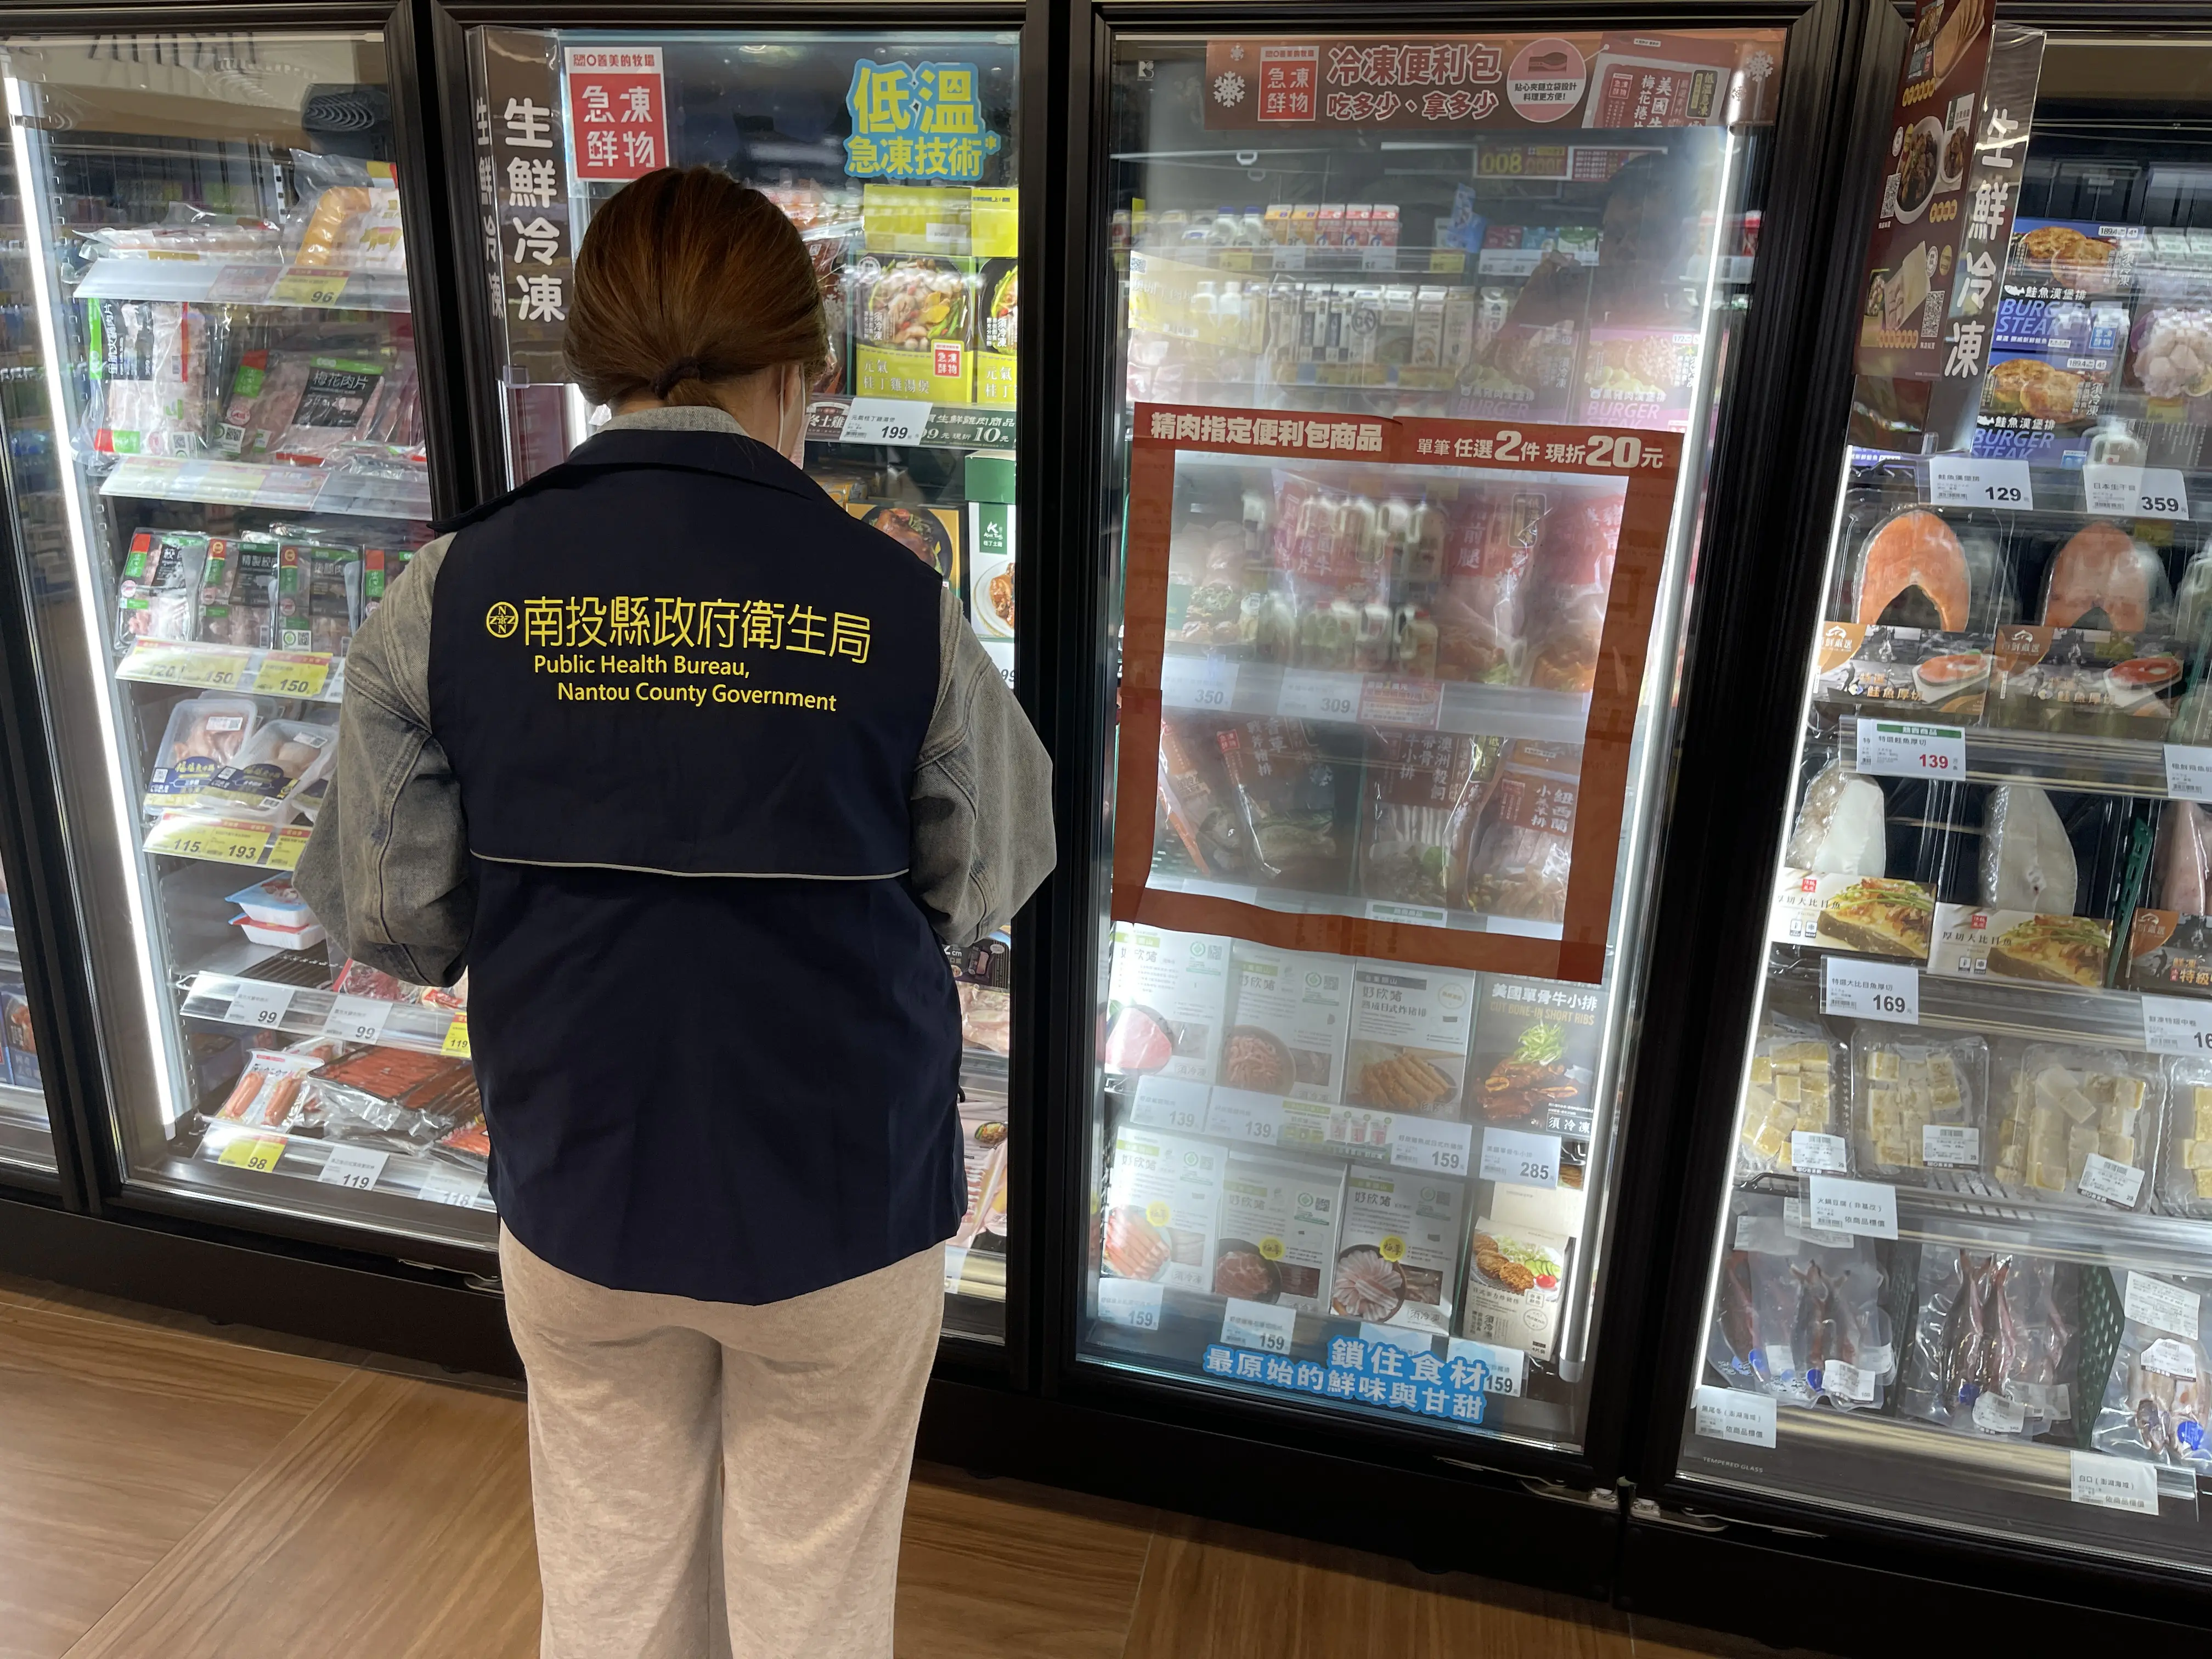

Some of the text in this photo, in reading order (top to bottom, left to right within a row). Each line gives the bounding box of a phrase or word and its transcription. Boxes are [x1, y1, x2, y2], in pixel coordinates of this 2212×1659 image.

[1327, 43, 1502, 86] 冷凍便利包
[1267, 67, 1309, 89] 急凍
[1514, 82, 1577, 92] 貼心夾鏈立袋設計
[582, 85, 653, 123] 急凍
[854, 65, 979, 136] 低溫
[1267, 92, 1308, 114] 鮮物
[1327, 89, 1499, 121] 吃多少、拿多少
[586, 130, 656, 168] 鮮物
[848, 136, 982, 178] 急凍技術
[504, 97, 566, 323] 生鮮冷凍
[1944, 108, 2019, 380] 生鮮冷凍
[311, 290, 334, 303] 96
[2025, 286, 2087, 301] 鮭魚漢堡排
[997, 318, 1007, 348] 須冷凍
[1996, 315, 2060, 336] STEAK
[864, 359, 888, 374] 元氣
[986, 366, 1012, 381] 元氣
[313, 370, 369, 390] 梅花肉片
[864, 376, 930, 394] 桂丁雞湯煲
[985, 383, 1017, 399] 桂丁
[2086, 382, 2104, 417] 須冷凍
[1587, 401, 1660, 419] BURGER
[1150, 411, 1383, 452] 精肉指定便利包商品
[1995, 416, 2056, 431] 鮭魚漢堡排
[882, 426, 909, 439] 199
[1974, 427, 2056, 449] BURGER
[1417, 430, 1664, 470] 單筆 任選2件 現折20元
[1985, 486, 2022, 501] 129
[2141, 496, 2179, 512] 359
[523, 595, 871, 664] 南投縣政府衛生局
[534, 655, 750, 679] Public Health Bureau,
[205, 671, 234, 685] 150
[280, 679, 309, 693] 150
[558, 682, 838, 712] Nantou County Government
[1195, 689, 1224, 706] 350
[1866, 685, 1923, 701] 鮭魚厚切
[1321, 697, 1351, 714] 309
[1878, 736, 1927, 747] 特選鮭魚厚切
[1920, 754, 1949, 769] 139
[174, 838, 202, 853] 115
[229, 845, 256, 859] 193
[1942, 930, 2013, 947] 厚切大比目魚
[1832, 978, 1893, 991] 特選大比目魚厚切
[2179, 969, 2212, 986] 特級
[1873, 994, 1905, 1013] 169
[258, 1011, 277, 1024] 99
[1490, 1001, 1595, 1025] CUT BONE-IN SHORT RIBS
[356, 1026, 375, 1039] 99
[450, 1039, 468, 1048] 119
[1169, 1110, 1195, 1128] 139
[1549, 1116, 1591, 1134] 須冷凍
[1245, 1121, 1272, 1138] 139
[247, 1157, 267, 1170] 98
[1431, 1150, 1459, 1169] 159
[1520, 1161, 1550, 1180] 285
[343, 1174, 370, 1189] 119
[1355, 1191, 1391, 1207] 好欣豬
[1844, 1216, 1886, 1227] 依商品標價
[1128, 1310, 1153, 1327] 159
[1260, 1334, 1285, 1351] 159
[1331, 1339, 1489, 1392] 鎖住食材
[1206, 1348, 1484, 1421] 最原始的鮮味與甘甜
[1486, 1374, 1513, 1393] 159
[1702, 1456, 1764, 1474] TEMPERED GLASS
